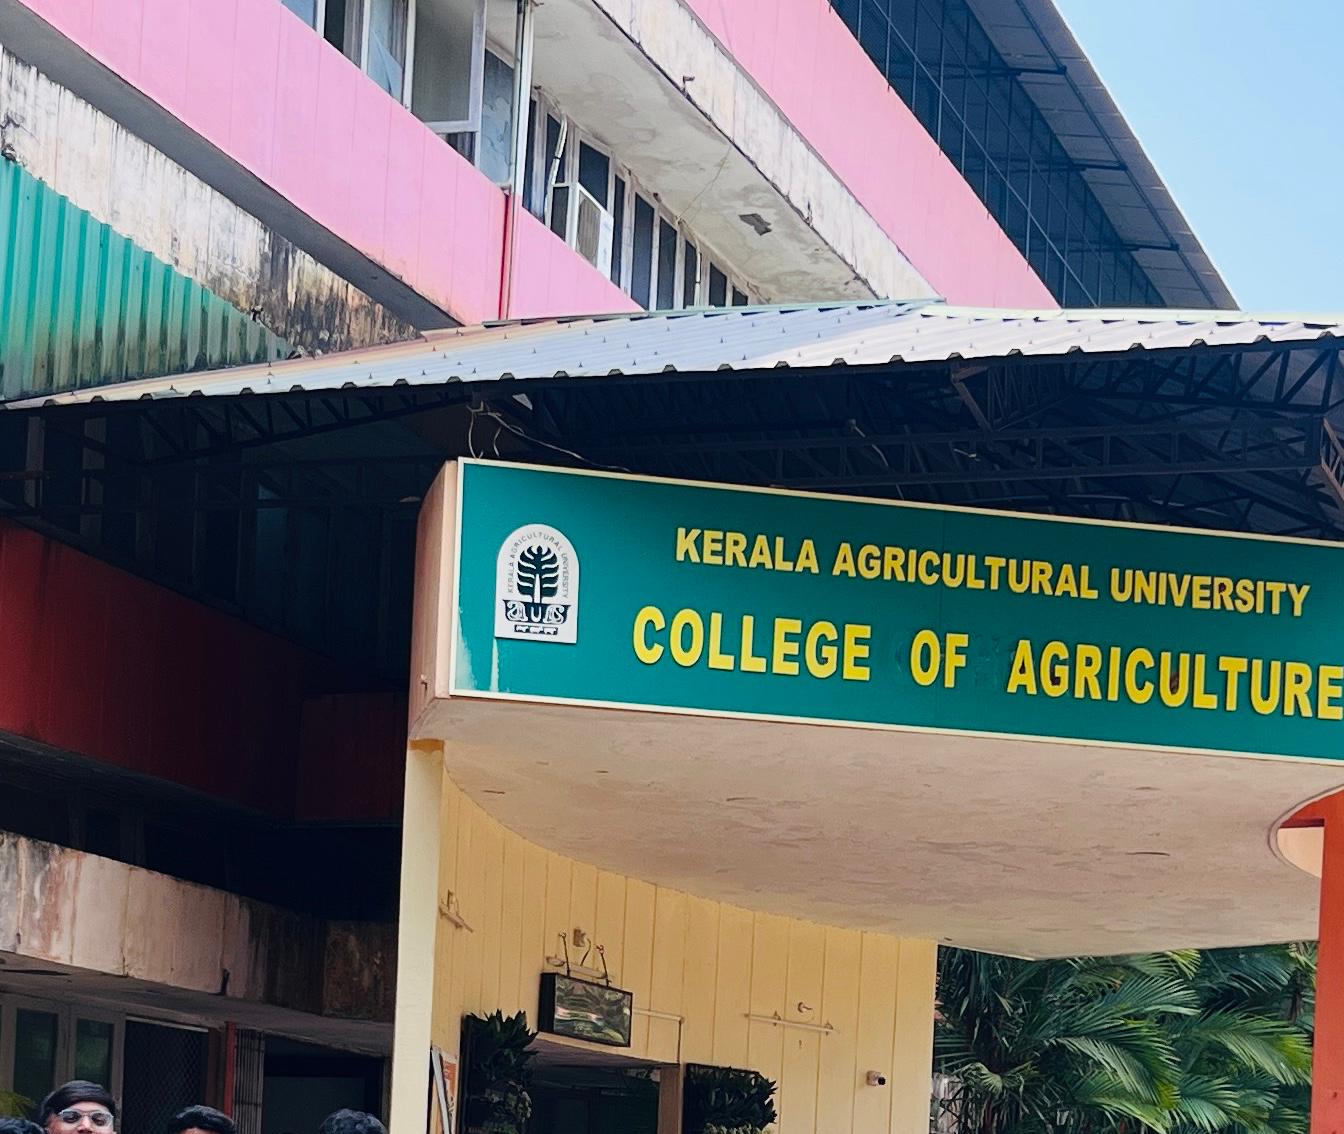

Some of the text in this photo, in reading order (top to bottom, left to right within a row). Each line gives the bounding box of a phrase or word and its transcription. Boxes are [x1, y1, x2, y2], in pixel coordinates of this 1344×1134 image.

[675, 527, 1311, 617] KERALA AGRICULTURAL UNIVERSITY
[632, 605, 1344, 720] COLLEGE OF AGRICULTURE
